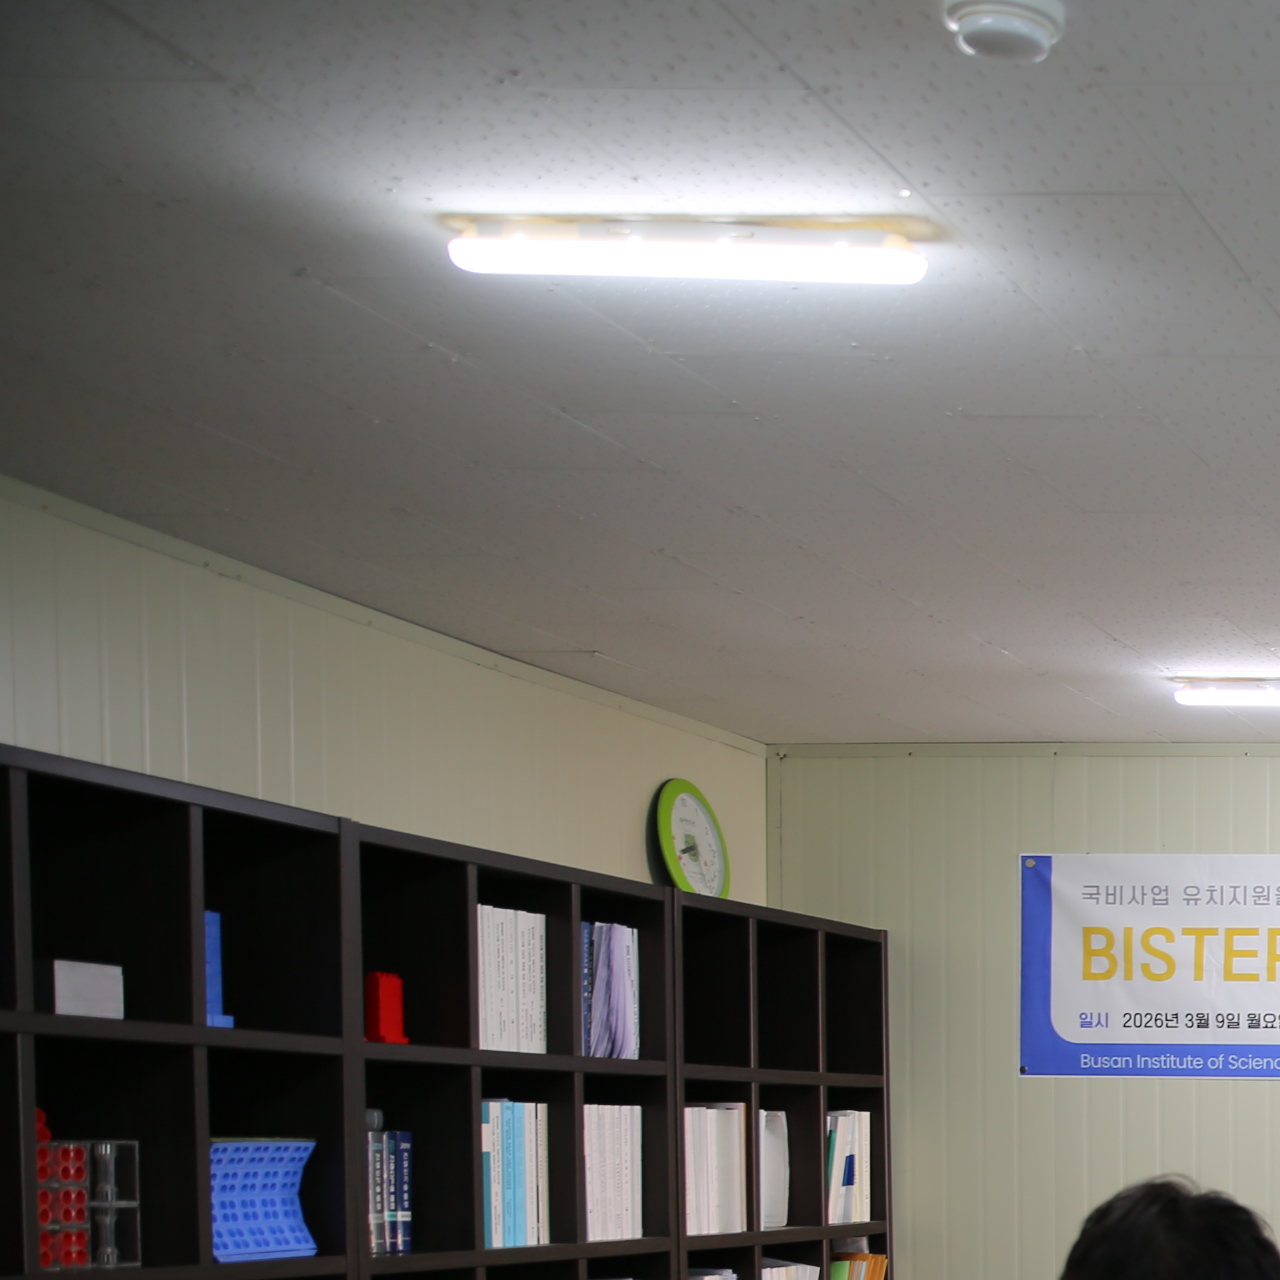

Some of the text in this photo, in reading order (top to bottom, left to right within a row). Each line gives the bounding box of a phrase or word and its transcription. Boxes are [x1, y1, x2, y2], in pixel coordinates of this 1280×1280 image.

[1081, 884, 1170, 907] 국비사업
[1079, 1011, 1109, 1029] 일시
[1122, 1012, 1180, 1030] 2026년
[1185, 1012, 1210, 1030] 3월
[1215, 1012, 1241, 1030] 9일
[1081, 1054, 1133, 1069] Busan
[1137, 1054, 1204, 1070] Institute
[1208, 1054, 1224, 1070] of
